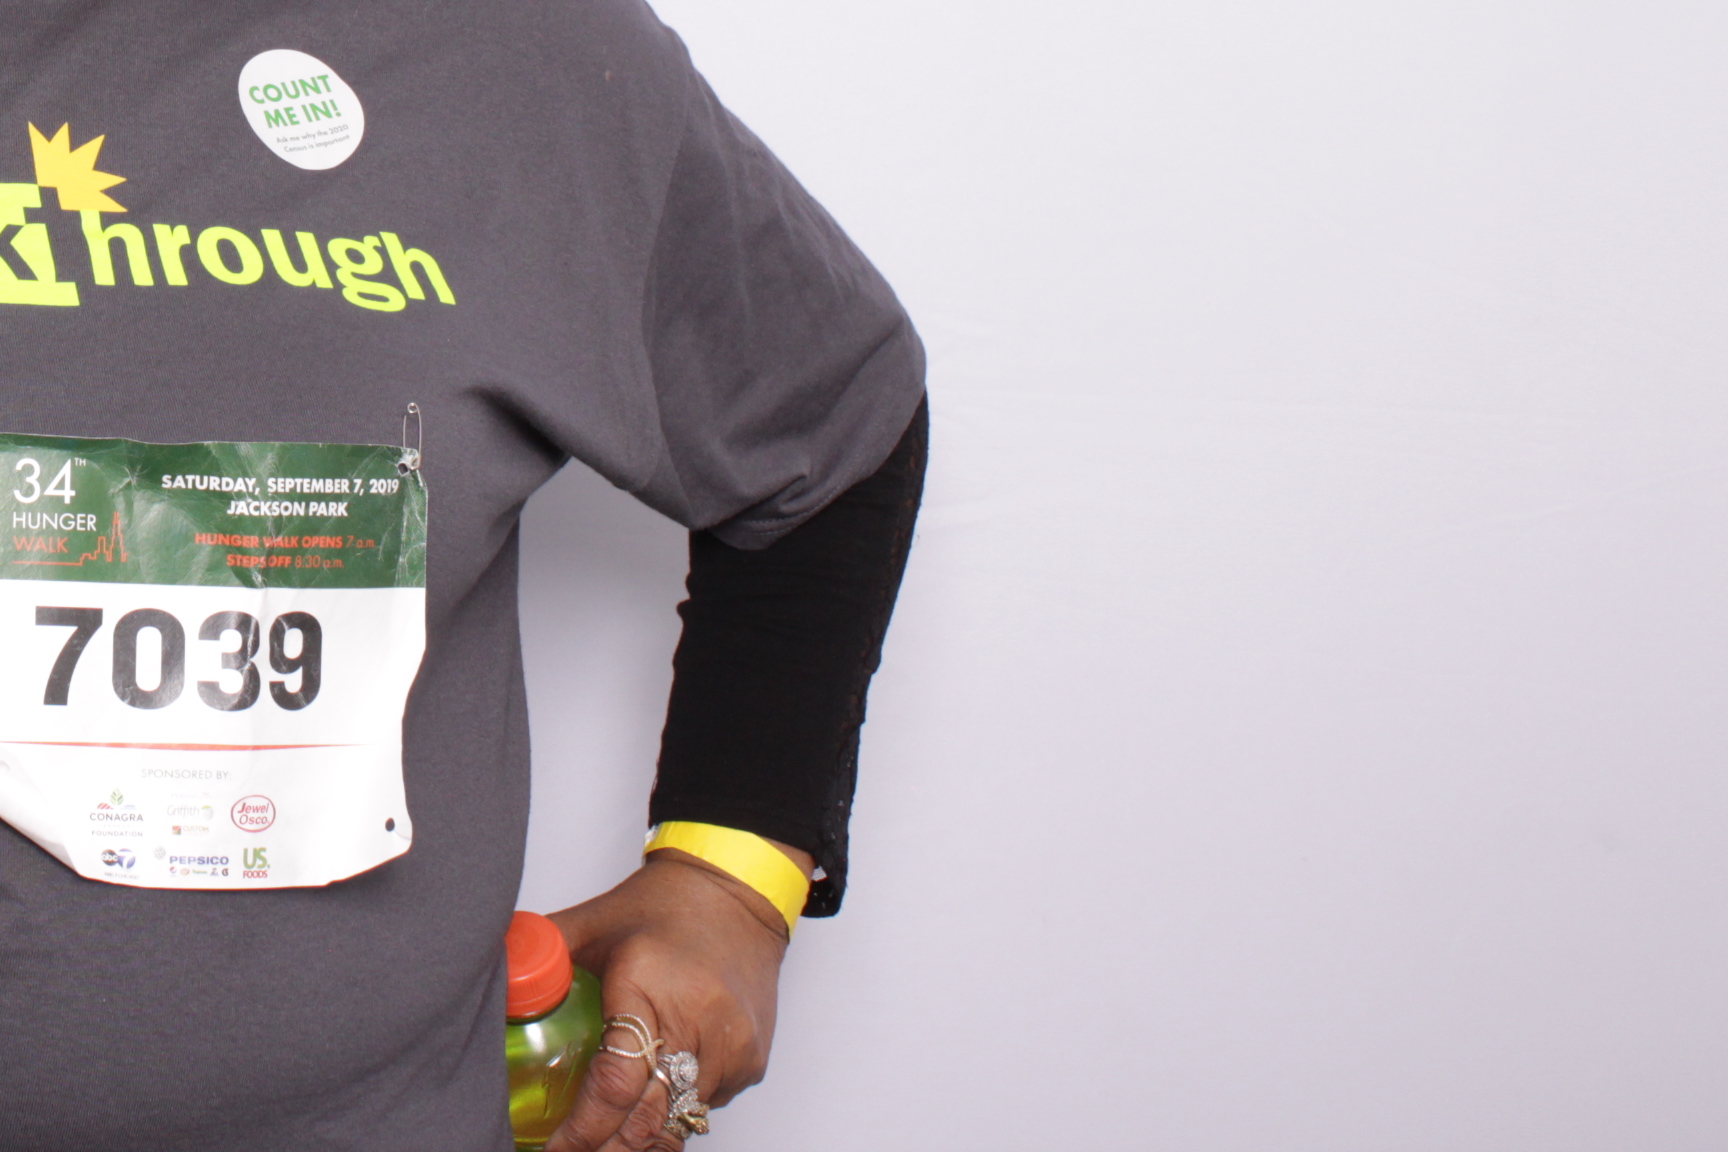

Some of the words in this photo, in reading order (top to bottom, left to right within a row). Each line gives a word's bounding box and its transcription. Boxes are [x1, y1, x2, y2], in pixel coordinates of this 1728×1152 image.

[248, 74, 332, 105] COUNT
[263, 107, 300, 129] ME
[301, 99, 342, 123] IN!
[276, 136, 289, 144] Ask
[301, 131, 316, 140] why
[316, 129, 329, 137] the
[329, 124, 349, 135] 2020
[284, 145, 308, 153] Census
[315, 134, 350, 148] important
[161, 474, 261, 496] SATURDAY,
[267, 477, 350, 494] SEPTEMBER
[353, 478, 365, 496] 7,
[369, 478, 400, 495] 2019
[227, 500, 306, 517] JACKSON
[308, 501, 349, 517] PARK
[12, 511, 97, 532] HUNGER
[12, 535, 69, 554] WALK
[194, 533, 260, 548] HUNGER
[263, 535, 299, 549] WALK
[301, 536, 344, 549] OPENS
[346, 535, 355, 548] 7
[226, 554, 267, 569] STEPS
[267, 555, 292, 568] OFF
[294, 554, 321, 568] 8:30
[322, 557, 344, 569] a.m.
[34, 605, 323, 713] 7039
[141, 768, 213, 780] SPONSORED
[215, 770, 232, 781] BY:
[166, 804, 200, 819] Griffith
[237, 802, 270, 814] Jewel
[89, 812, 144, 822] CONAGRA
[91, 830, 144, 838] FOUNDATION
[169, 855, 230, 866] PEPSICO
[242, 869, 268, 879] FOODS
